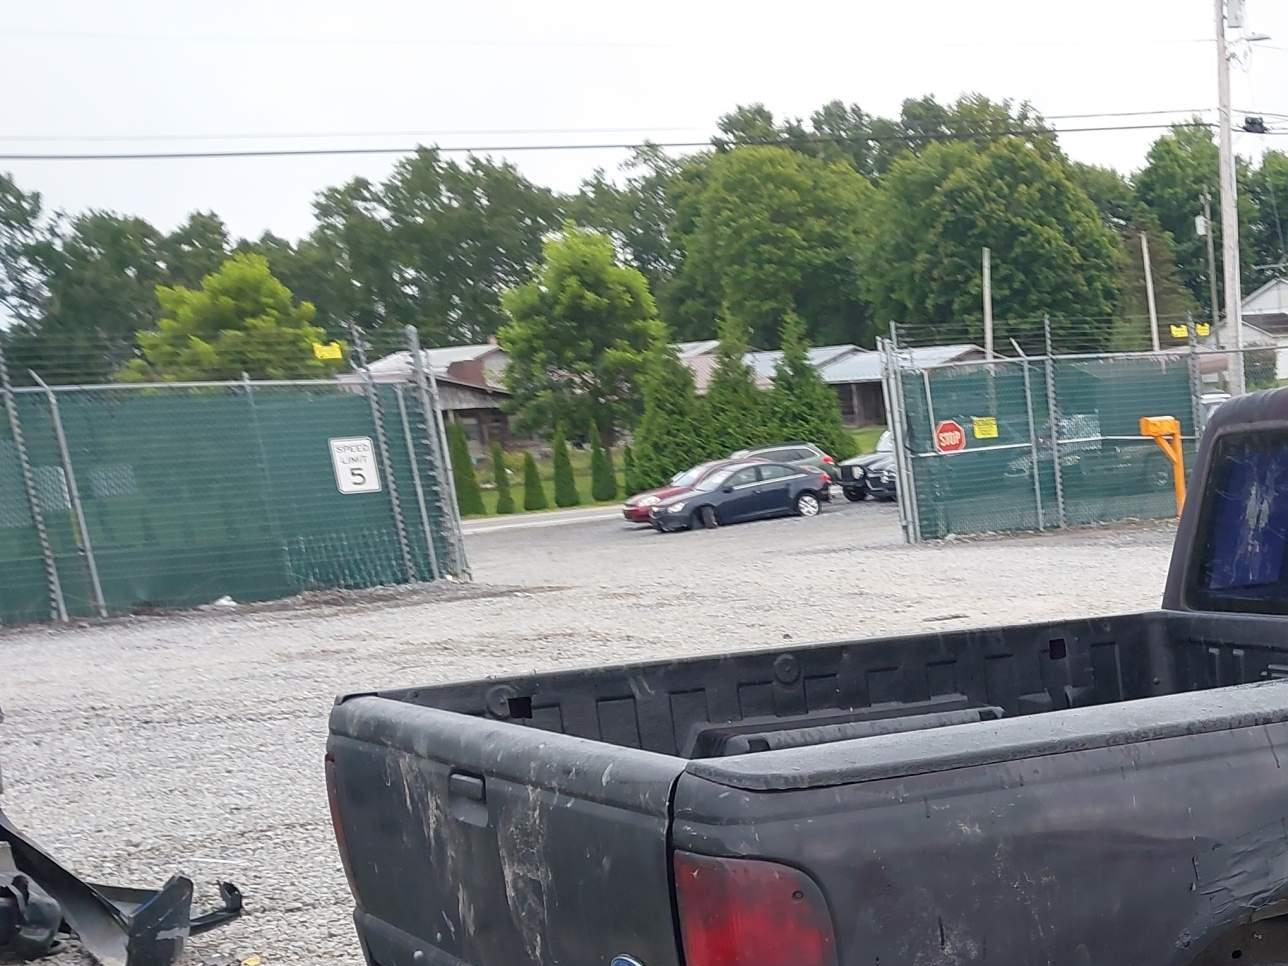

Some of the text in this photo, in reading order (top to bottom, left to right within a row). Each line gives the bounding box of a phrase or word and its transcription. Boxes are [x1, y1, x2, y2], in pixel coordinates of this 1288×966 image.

[939, 431, 961, 447] STOP
[336, 443, 369, 453] SPEED
[340, 455, 368, 465] LIMIT
[350, 467, 367, 486] 5
